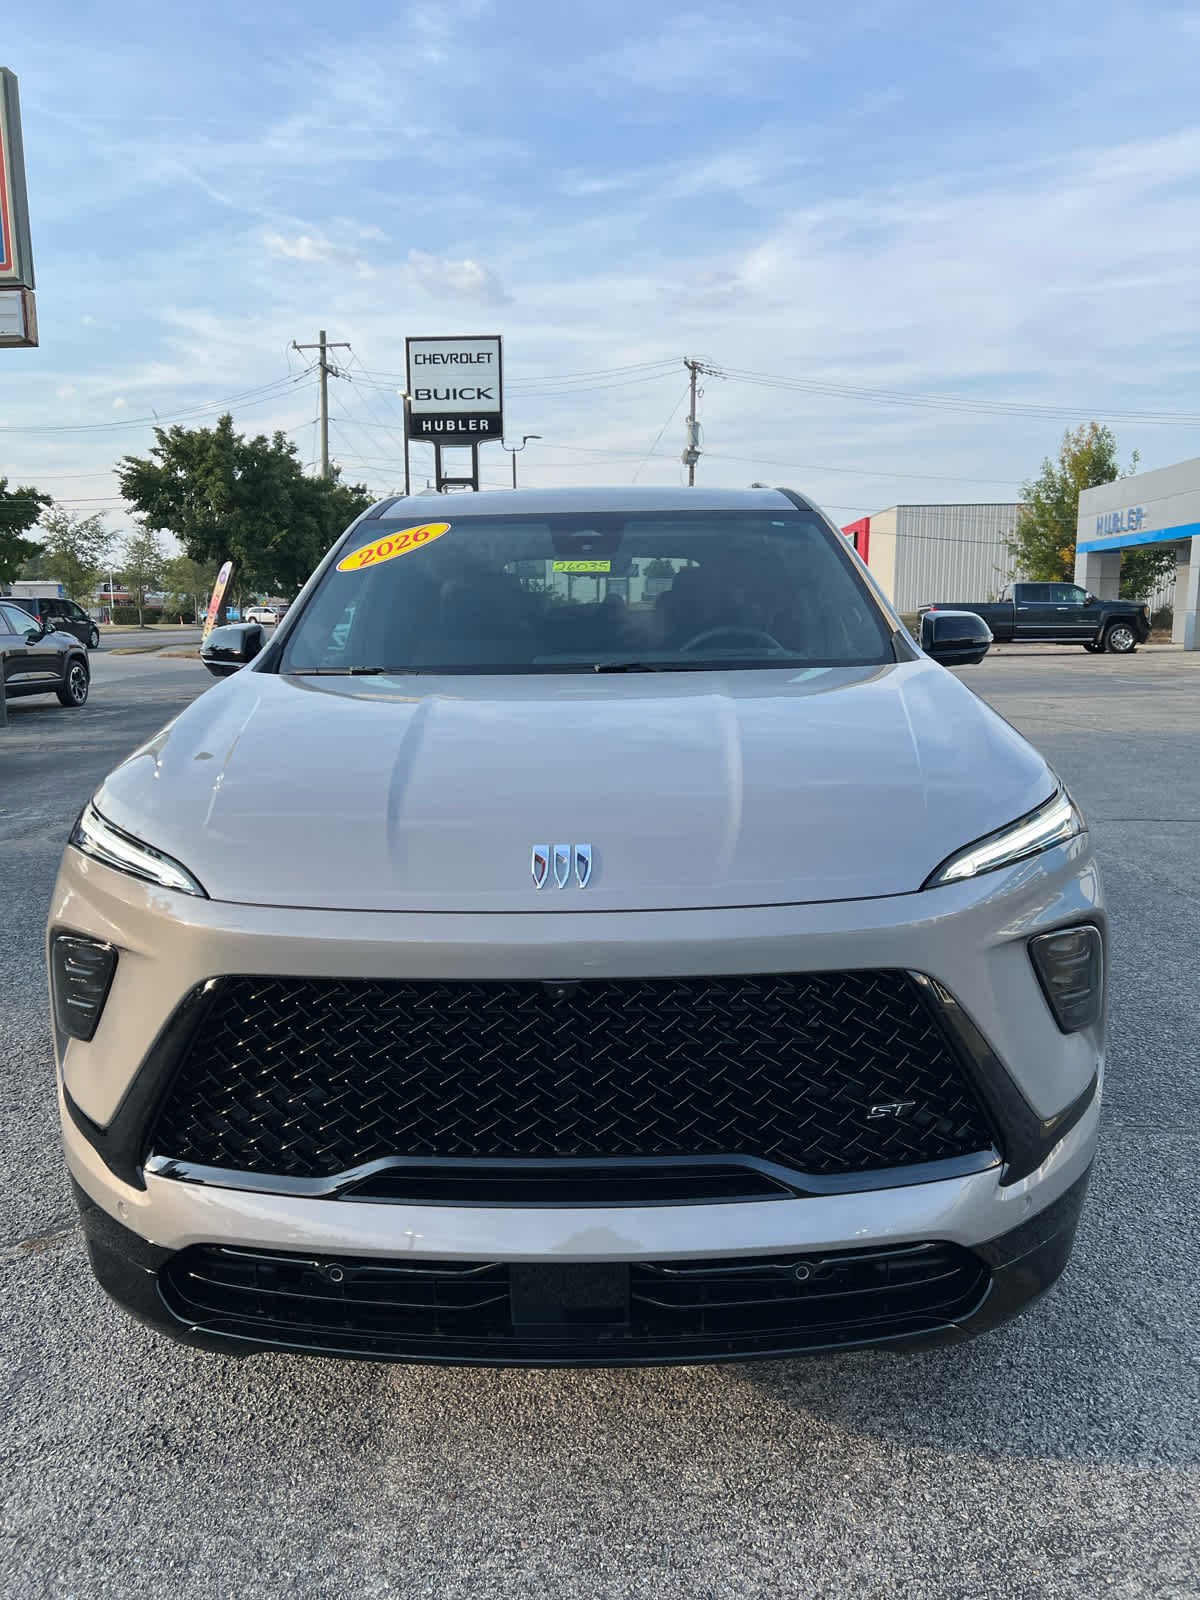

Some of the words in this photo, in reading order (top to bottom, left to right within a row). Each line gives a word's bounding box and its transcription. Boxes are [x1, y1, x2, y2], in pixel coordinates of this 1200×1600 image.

[414, 352, 493, 365] CHEVROLET
[415, 387, 494, 401] BUICK
[422, 419, 489, 432] HUBLER
[1096, 507, 1144, 537] HUBLER
[358, 526, 430, 567] 2026
[866, 1101, 916, 1119] ST
